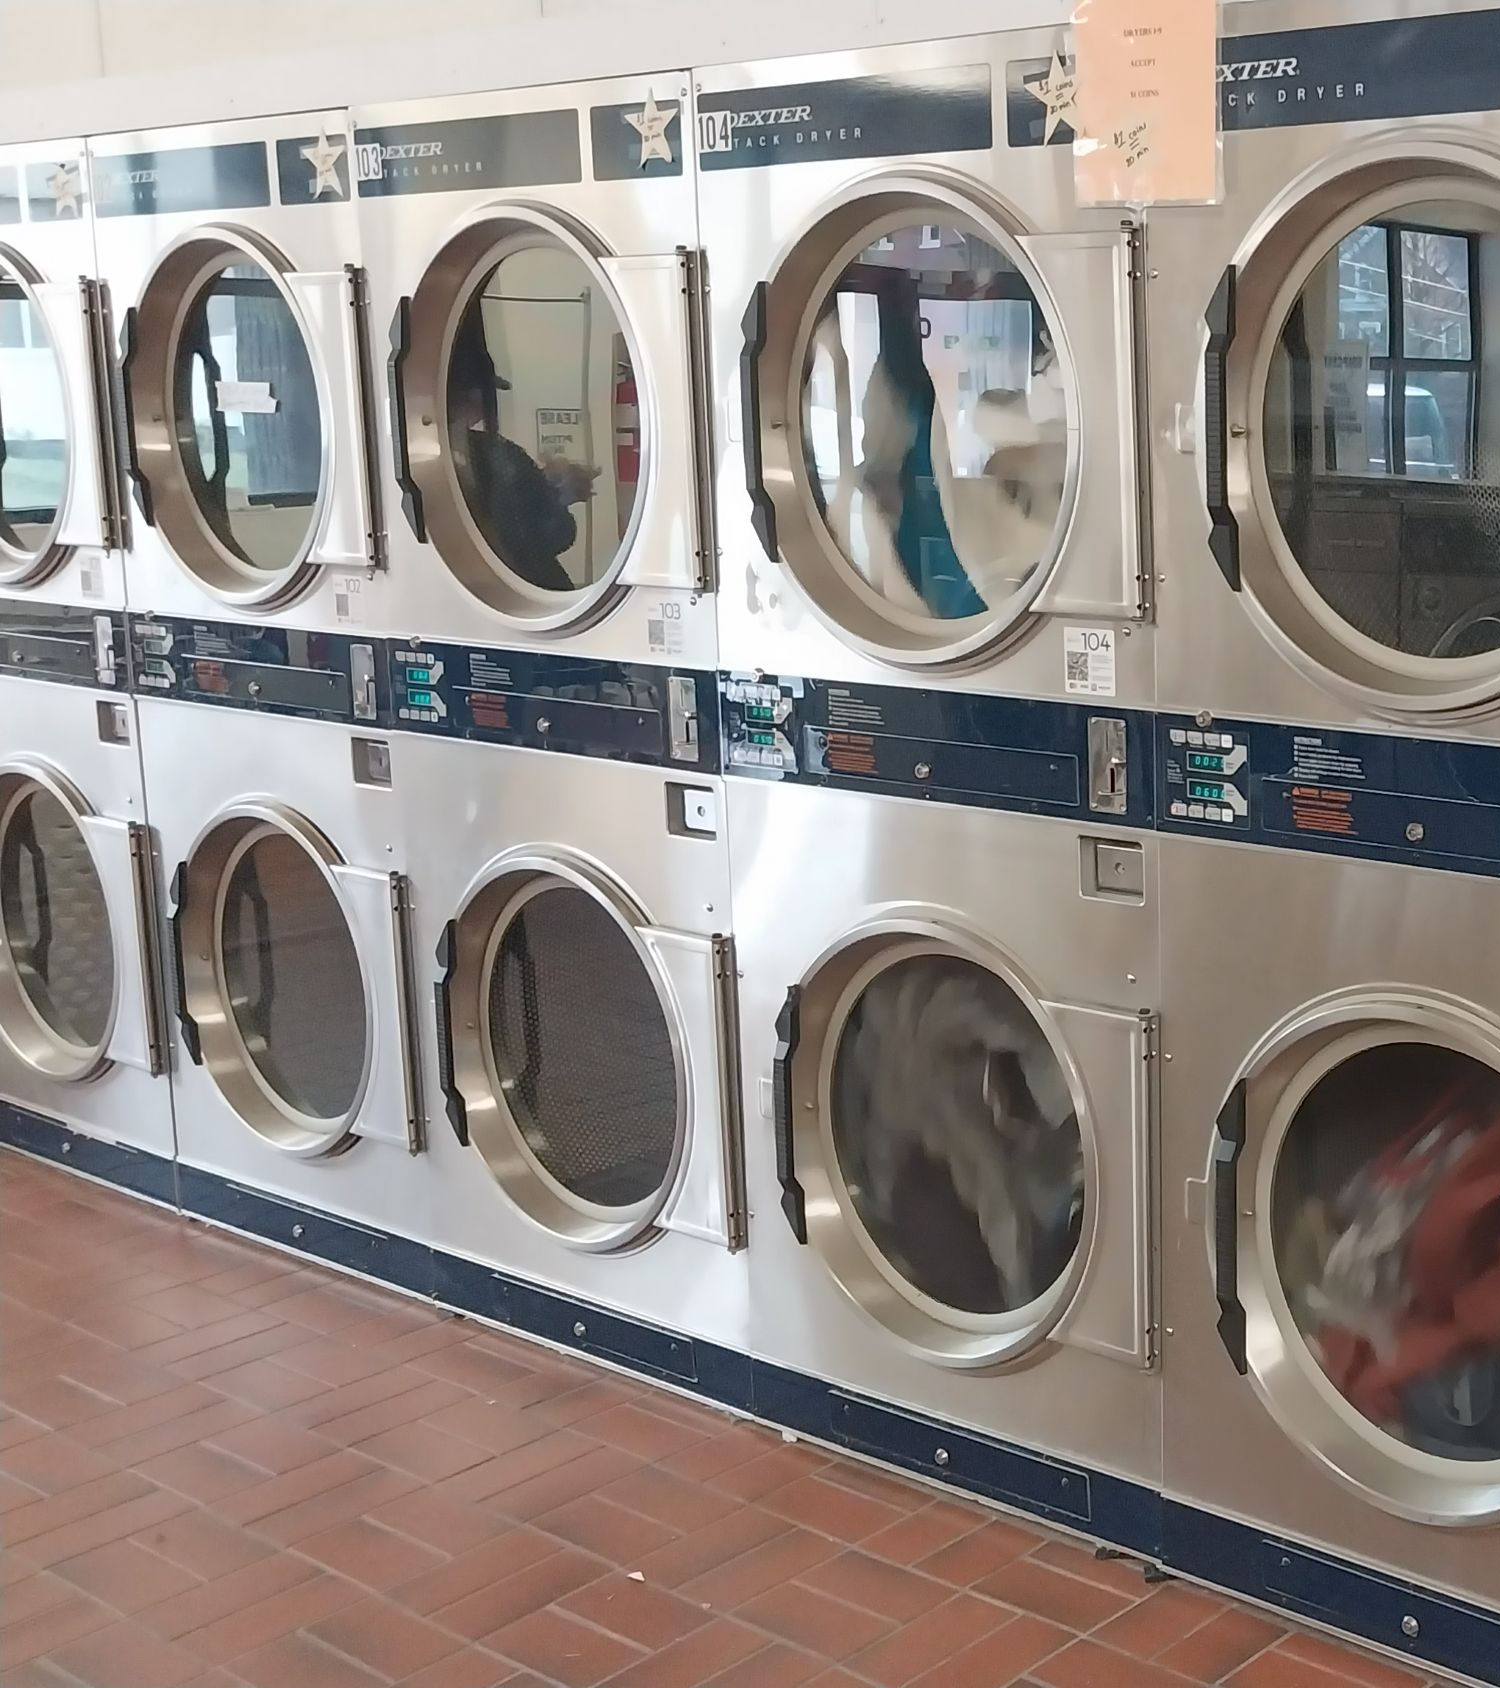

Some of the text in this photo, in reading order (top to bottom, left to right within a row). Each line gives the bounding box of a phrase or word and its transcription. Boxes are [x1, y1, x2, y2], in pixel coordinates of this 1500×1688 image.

[1216, 57, 1298, 83] XTER
[1278, 83, 1364, 103] DRYER
[730, 105, 812, 128] DEXTER
[700, 114, 730, 150] 104
[734, 127, 862, 149] TACK DRYER
[357, 145, 381, 177] 103
[379, 142, 442, 160] DEXTER
[383, 161, 482, 178] TACK DRYER
[659, 602, 681, 620] 103
[1081, 632, 1111, 652] 104
